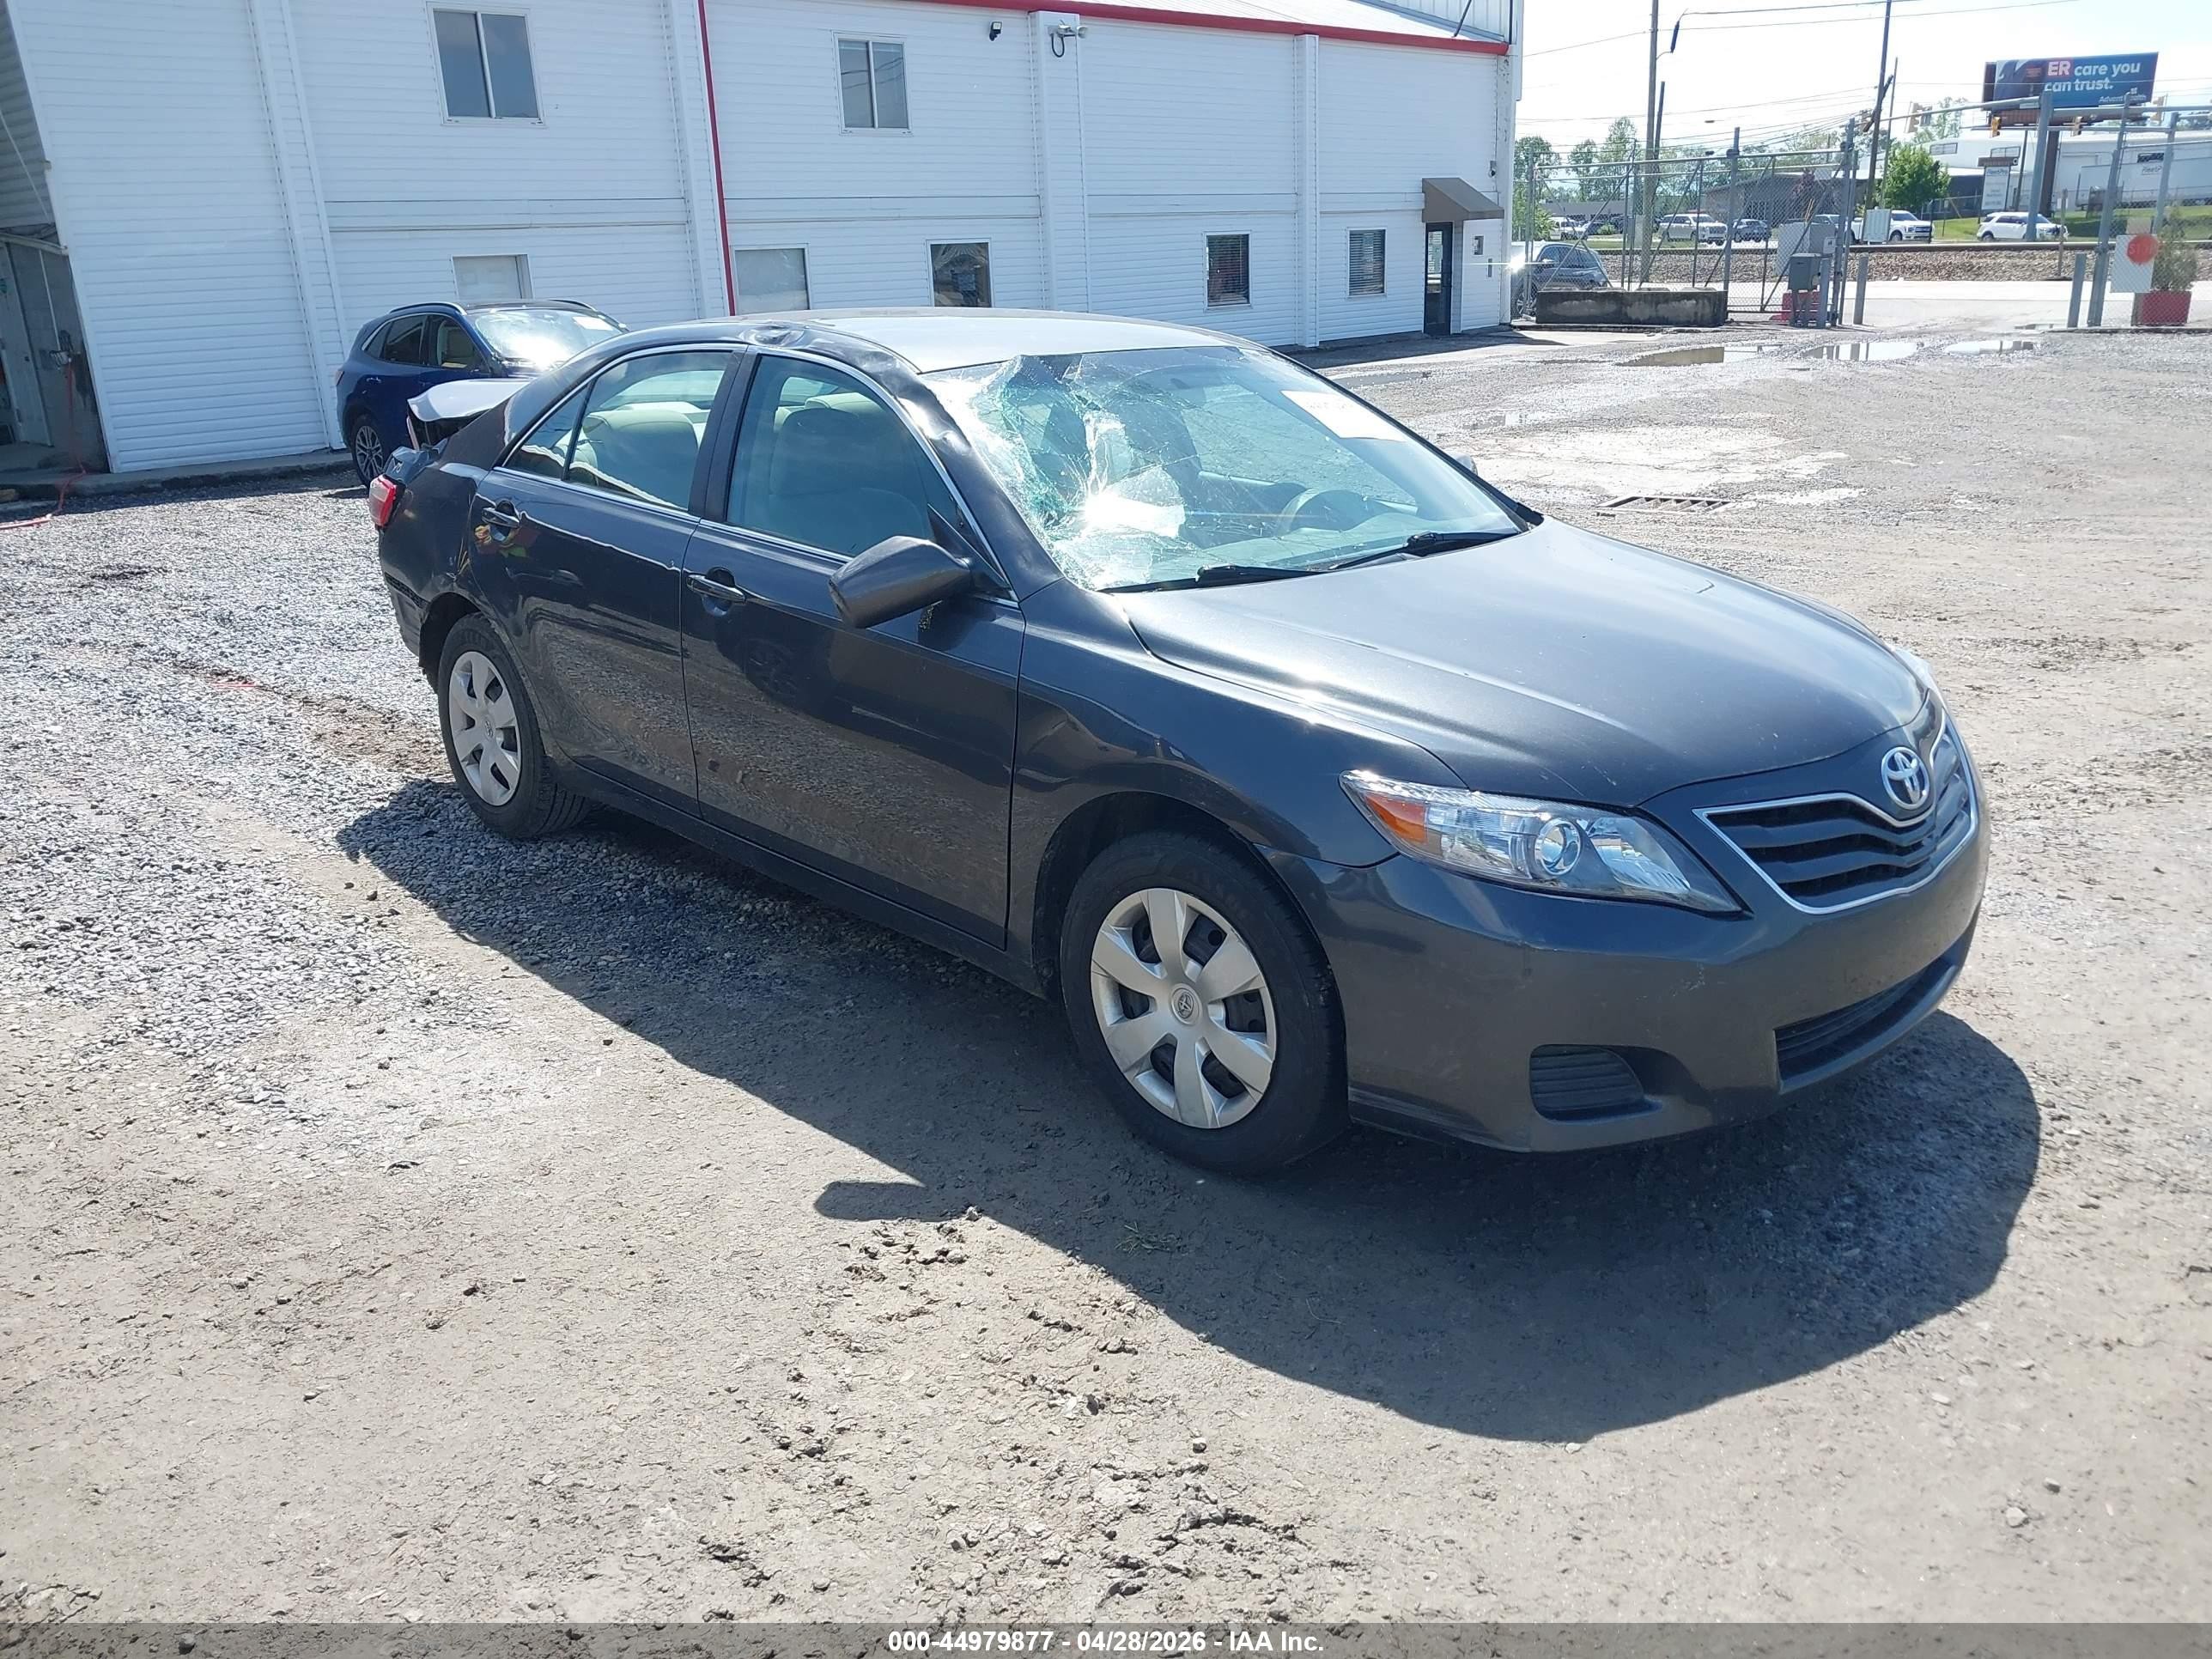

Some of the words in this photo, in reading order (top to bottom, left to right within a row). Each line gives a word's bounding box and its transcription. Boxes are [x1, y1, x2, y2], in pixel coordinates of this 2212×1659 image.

[2047, 61, 2071, 76] ER
[2074, 64, 2108, 76] care
[2112, 62, 2141, 77] you
[2044, 81, 2071, 92] can
[2074, 76, 2113, 91] trust.
